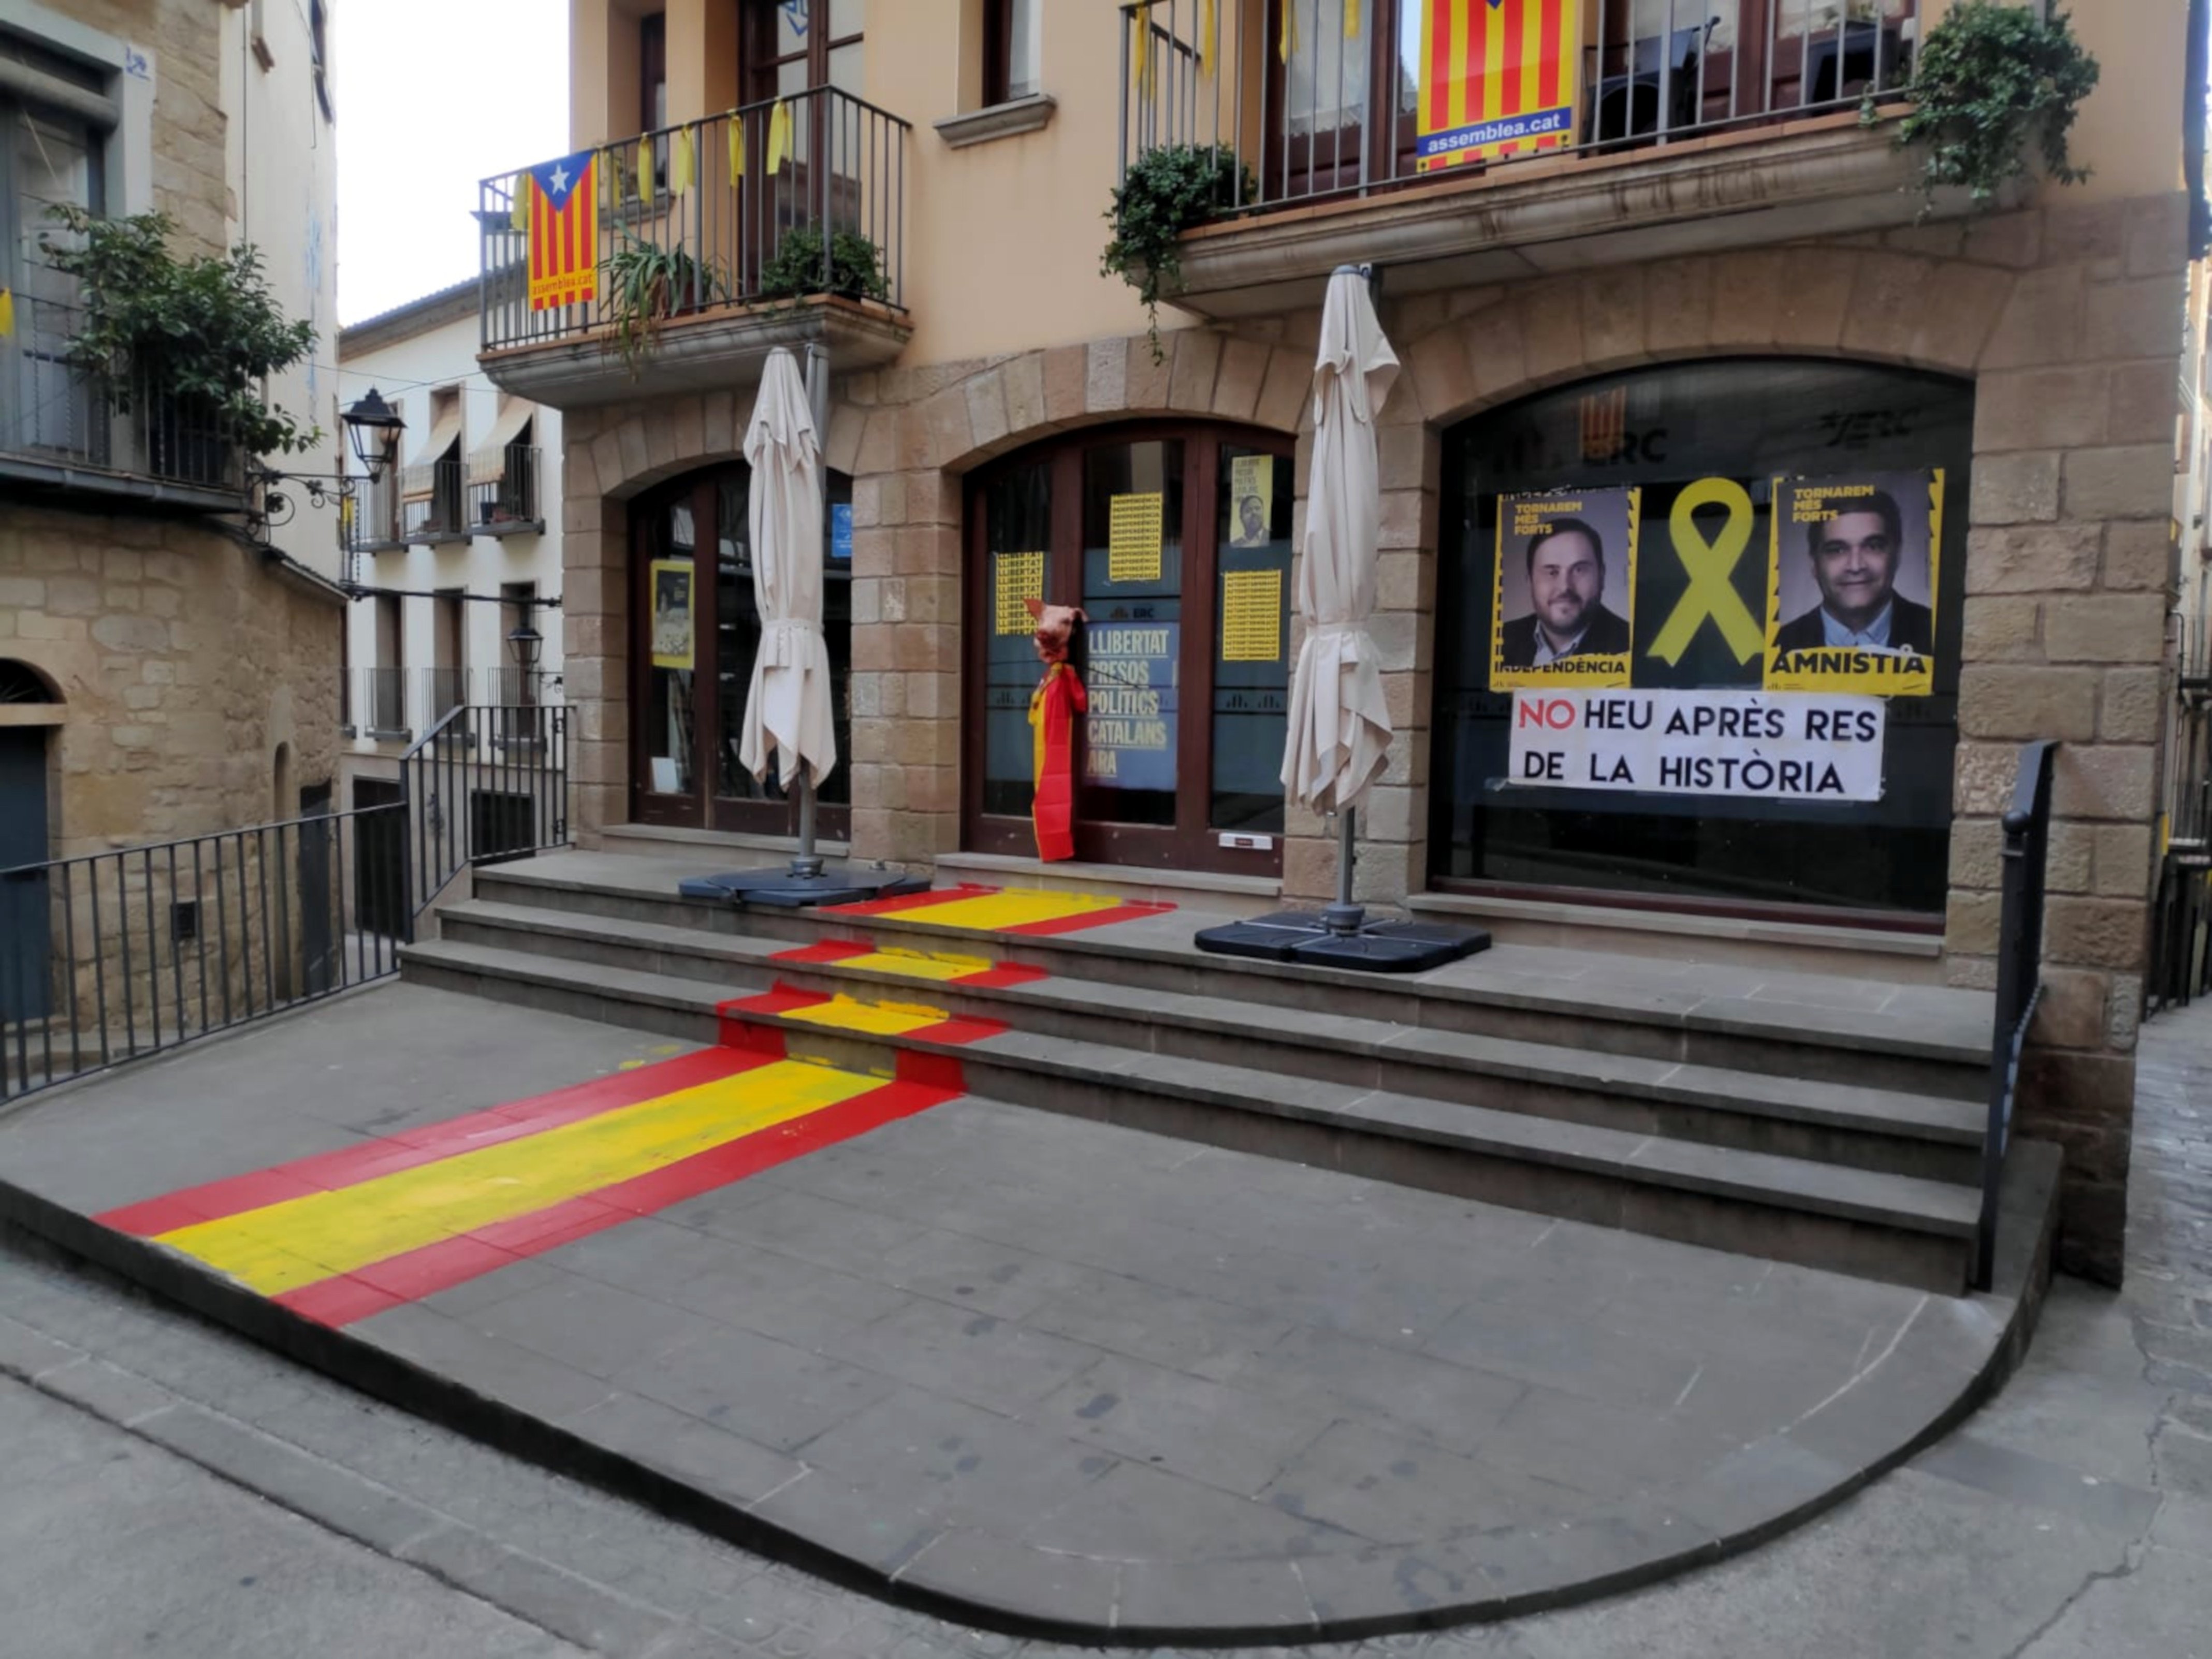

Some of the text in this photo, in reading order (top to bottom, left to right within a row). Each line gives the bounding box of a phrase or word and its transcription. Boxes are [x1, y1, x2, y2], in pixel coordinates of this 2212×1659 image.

[1428, 113, 1560, 153] assemblea.cat
[532, 274, 592, 295] assemblea.cat
[1794, 485, 1874, 500] TORNAREM
[1515, 501, 1582, 514] TORNAREM
[1792, 510, 1838, 523] FORTS
[1515, 523, 1552, 535] FORTS
[1088, 630, 1169, 654] LLIBERTAT
[1088, 660, 1149, 685] PRESOS
[1770, 651, 1926, 674] AMNISTIA
[1088, 689, 1159, 714] POLÍTICS
[1518, 697, 1876, 742] NO HEU APRÈS RES
[1088, 720, 1167, 745] CATALANS
[1088, 750, 1117, 774] ARA
[1524, 748, 1845, 794] DE LA HISTÒRIA
